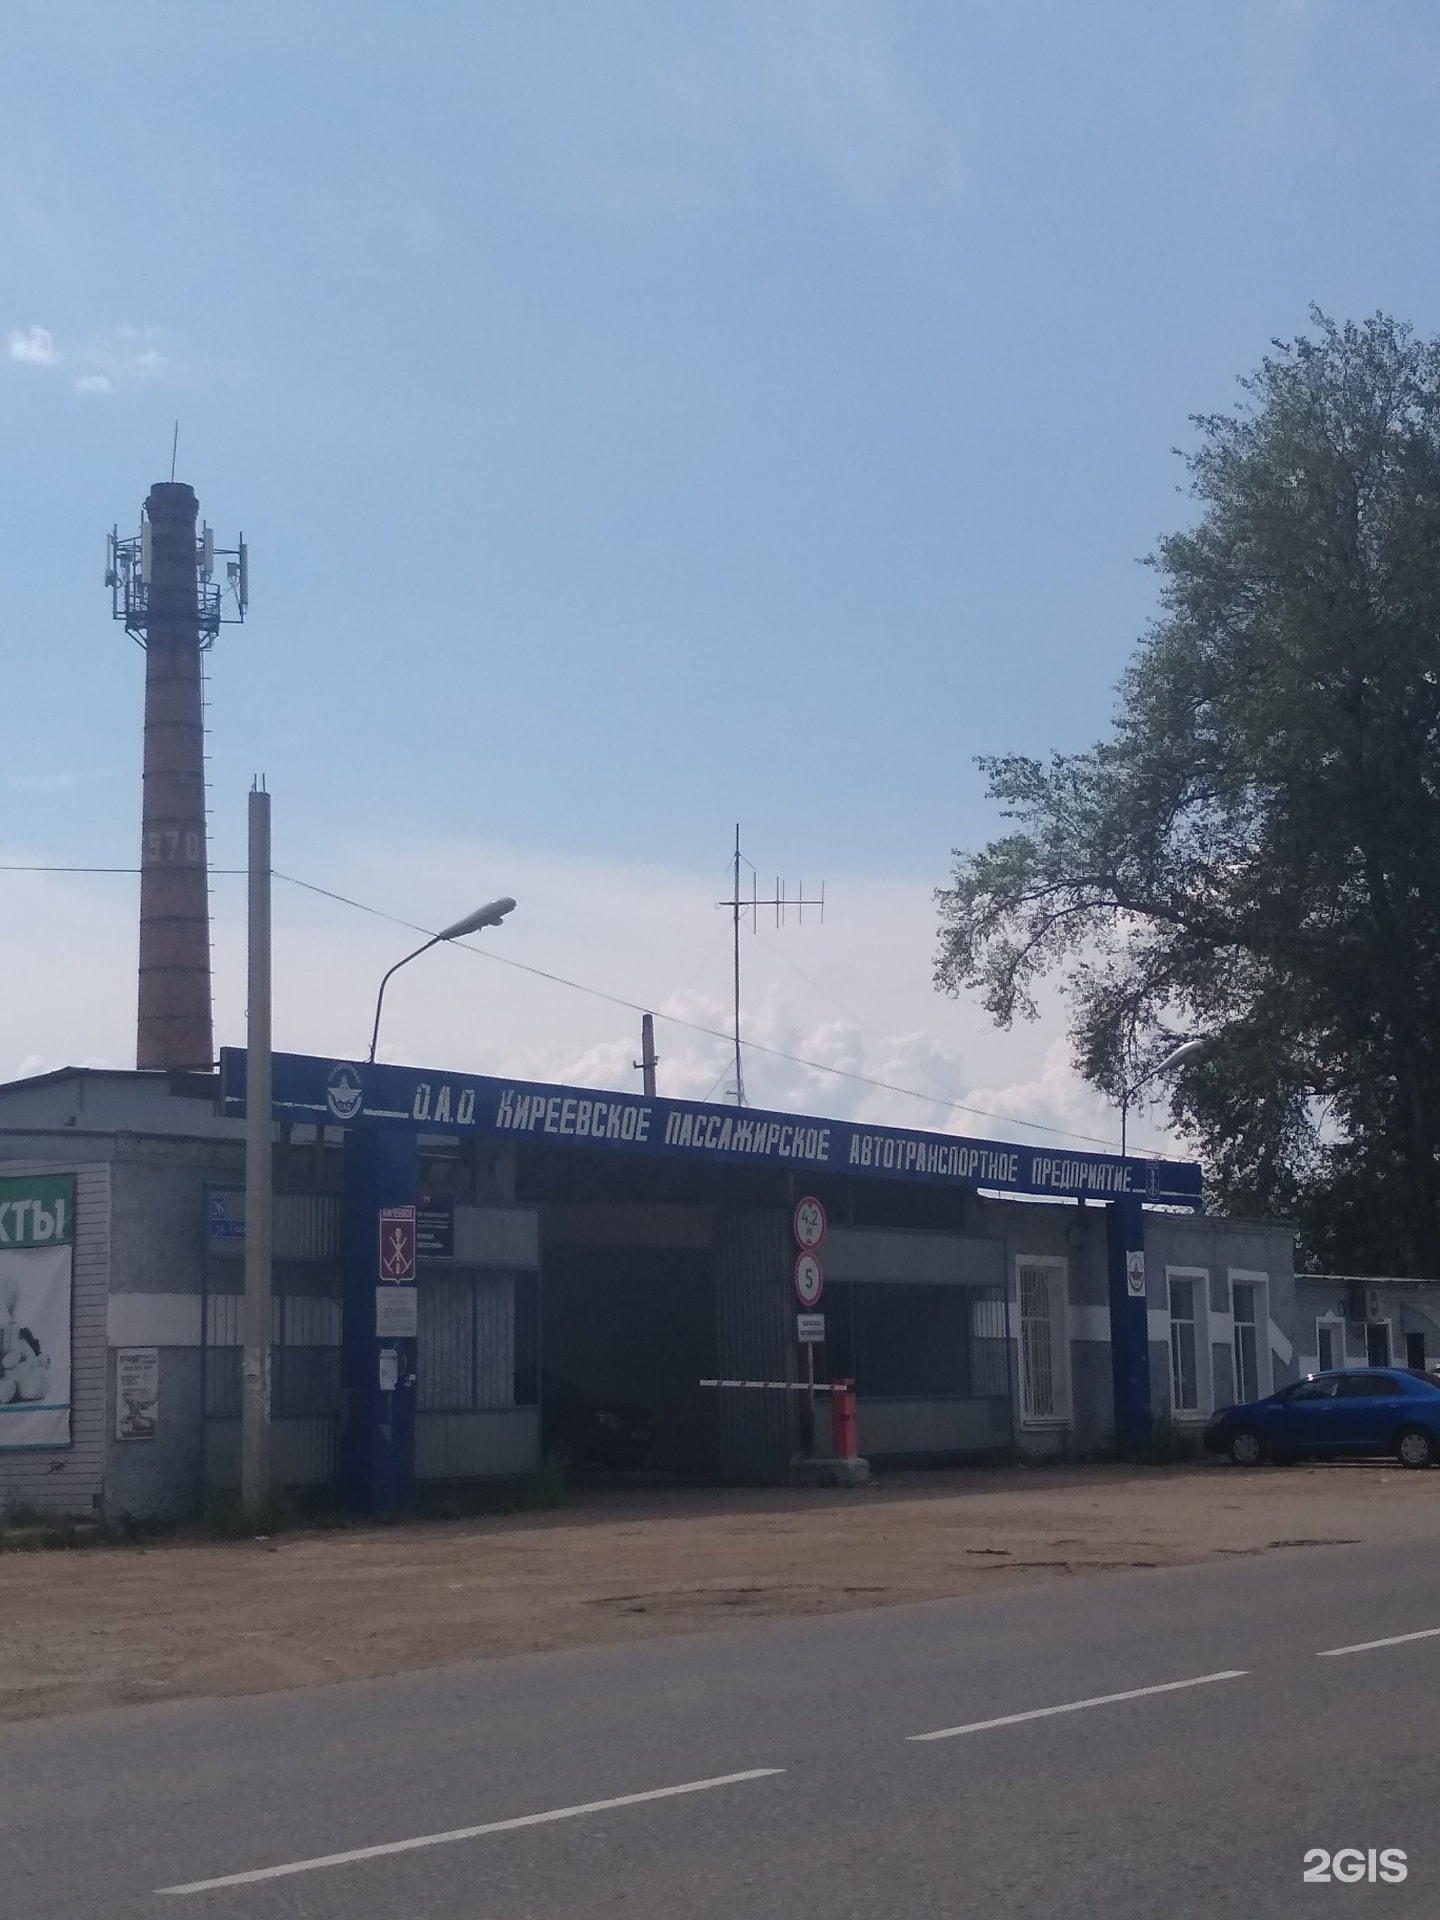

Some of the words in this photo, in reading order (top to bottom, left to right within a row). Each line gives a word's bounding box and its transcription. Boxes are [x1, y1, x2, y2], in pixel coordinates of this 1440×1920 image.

[413, 1083, 475, 1124] О.А.О.
[496, 1089, 652, 1141] КИРЕЕВСКОЕ
[664, 1111, 830, 1160] ПАССАЖИРСКОЕ
[849, 1134, 1018, 1182] АВТОТРАНСПОРТНОЕ
[1031, 1157, 1132, 1192] ПРЕДПРИЯТИЕ
[801, 1210, 818, 1226] 4,2
[805, 1269, 813, 1289] 5
